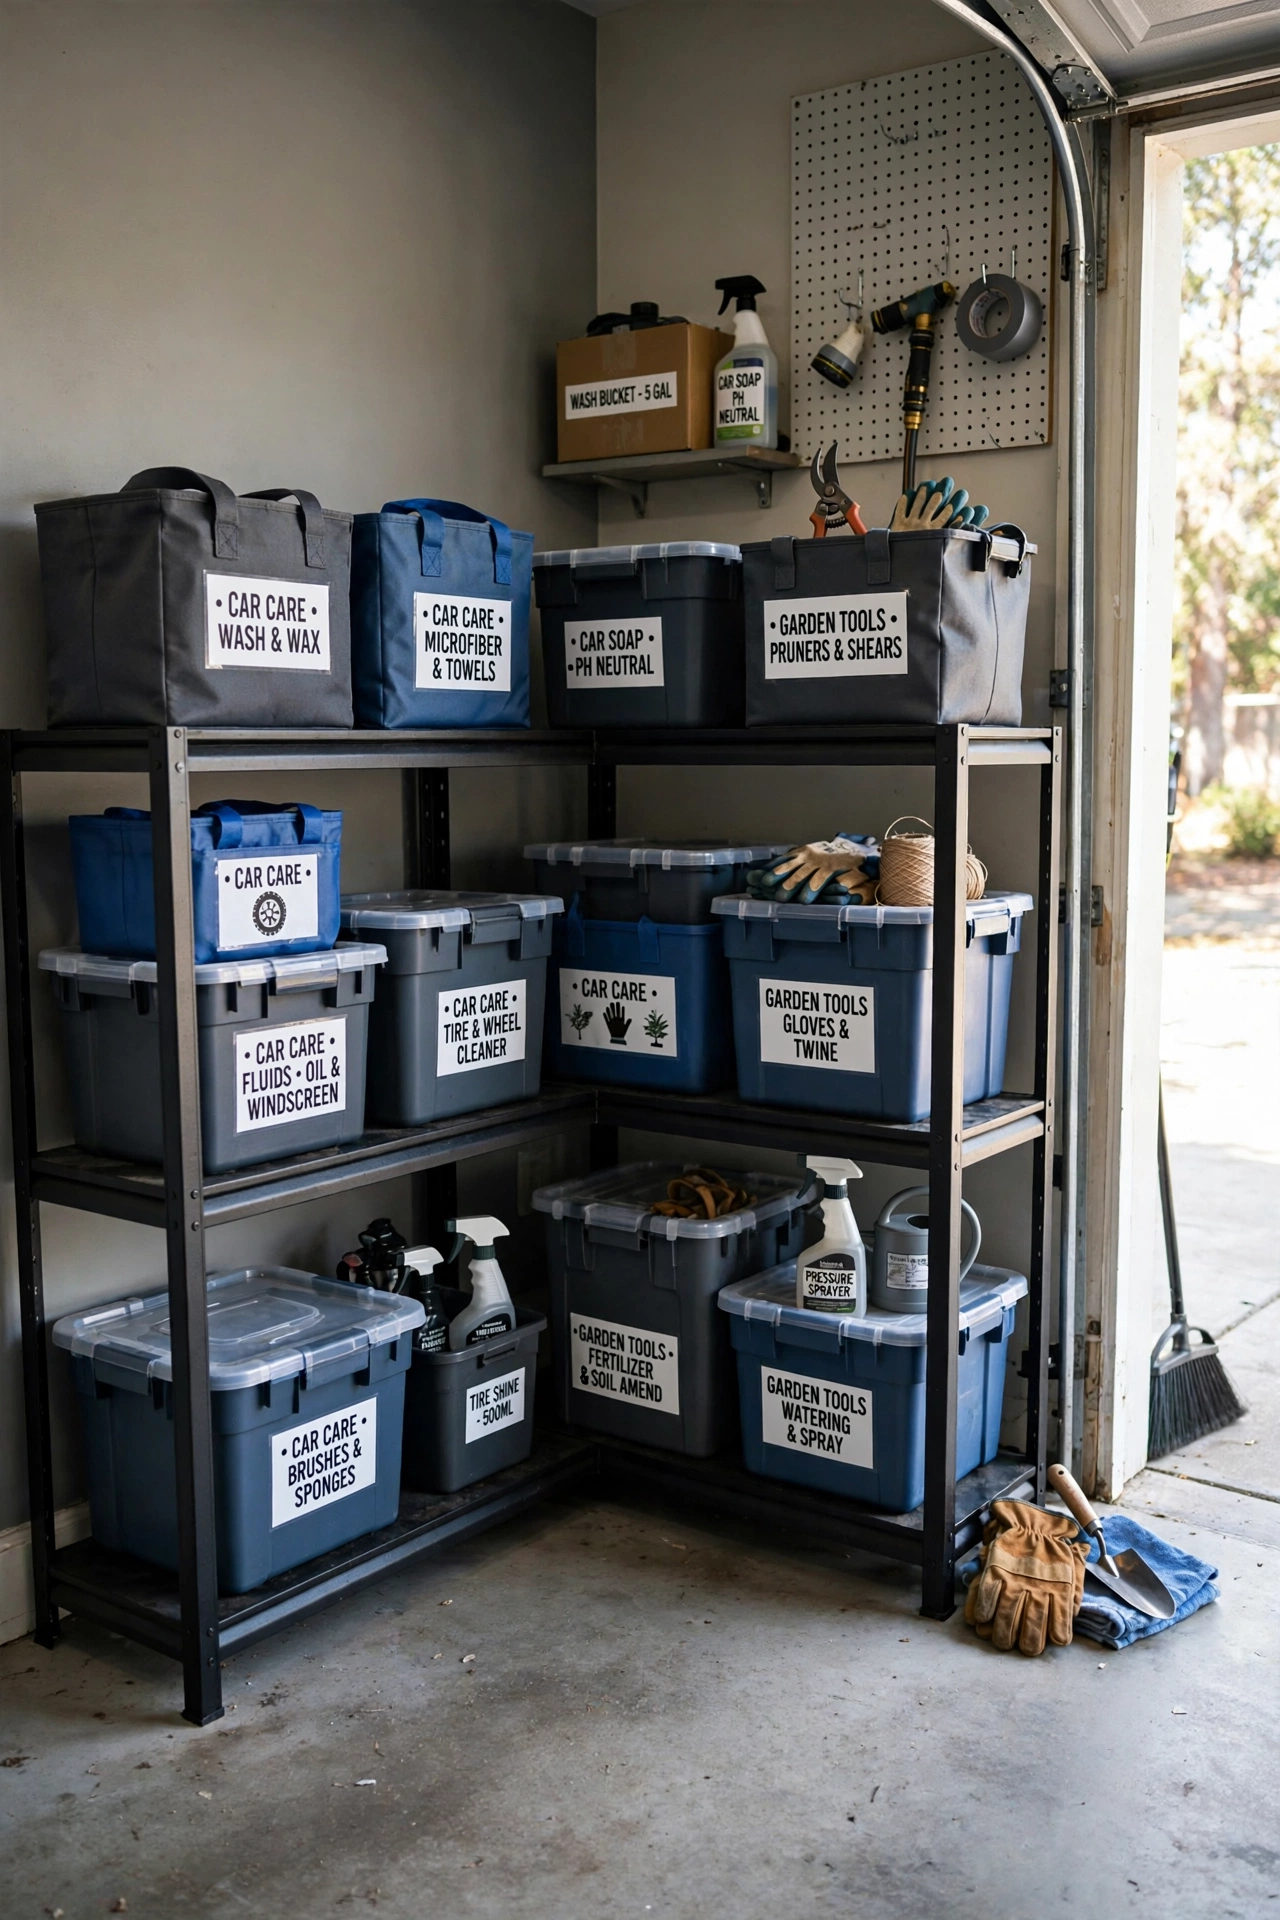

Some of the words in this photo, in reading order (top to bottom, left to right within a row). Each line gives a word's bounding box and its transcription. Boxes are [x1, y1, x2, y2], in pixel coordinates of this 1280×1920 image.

[718, 375, 734, 390] CAR
[736, 372, 761, 388] SOAP
[570, 391, 597, 410] WASH
[600, 386, 636, 406] BUCKET
[645, 385, 650, 400] 5
[653, 382, 672, 399] GAL
[732, 391, 744, 406] PH
[719, 406, 760, 424] NEUTRAL
[228, 591, 261, 619] CAR
[266, 594, 306, 622] CARE
[433, 604, 459, 627] CAR
[462, 605, 494, 629] CARE
[780, 611, 836, 636] GARDEN
[839, 608, 886, 632] TOOLS
[218, 623, 265, 651] WASH
[271, 627, 282, 652] &
[287, 628, 321, 654] WAX
[425, 630, 502, 656] MICROFIBER
[580, 631, 606, 652] CAR
[609, 629, 643, 650] SOAP
[770, 639, 830, 663] PRUNERS
[834, 639, 844, 661] &
[848, 636, 902, 660] SHEARS
[433, 657, 442, 679] &
[446, 658, 495, 682] TOWELS
[576, 657, 592, 676] PH
[596, 654, 654, 676] NEUTRAL
[235, 867, 262, 889] CAR
[267, 864, 302, 887] CARE
[453, 996, 476, 1018] CAR
[480, 990, 508, 1012] CARE
[582, 978, 607, 999] CAR
[612, 980, 647, 1002] CARE
[766, 988, 819, 1012] GARDEN
[823, 993, 867, 1016] TOOLS
[444, 1019, 469, 1044] TIRE
[472, 1019, 480, 1039] &
[483, 1012, 521, 1036] WHEEL
[783, 1014, 835, 1038] GLOVES
[839, 1019, 849, 1040] &
[256, 1039, 284, 1065] CAR
[289, 1032, 324, 1059] CARE
[457, 1038, 507, 1065] CLEANER
[794, 1039, 838, 1062] TWINE
[242, 1066, 292, 1094] FLUIDS
[306, 1060, 327, 1082] OIL
[331, 1055, 340, 1077] &
[248, 1081, 338, 1120] WINDSCREEN
[805, 1270, 854, 1285] PRESSURE
[808, 1284, 850, 1297] SPRAYER
[579, 1325, 625, 1352] GARDEN
[628, 1334, 666, 1361] TOOLS
[588, 1347, 653, 1380] FERTILIZER
[470, 1388, 490, 1412] TIRE
[493, 1377, 519, 1404] SHINE
[580, 1365, 589, 1385] &
[591, 1369, 616, 1393] SOIL
[619, 1376, 662, 1403] AMEND
[767, 1375, 820, 1405] GARDEN
[823, 1387, 867, 1416] TOOLS
[483, 1399, 513, 1426] 500ML
[781, 1400, 851, 1435] WATERING
[292, 1430, 318, 1458] CAR
[323, 1414, 357, 1446] CARE
[787, 1424, 796, 1443] &
[800, 1427, 843, 1455] SPRAY
[289, 1442, 349, 1486] BRUSHES
[353, 1438, 361, 1458] &
[295, 1465, 355, 1508] SPONGES
